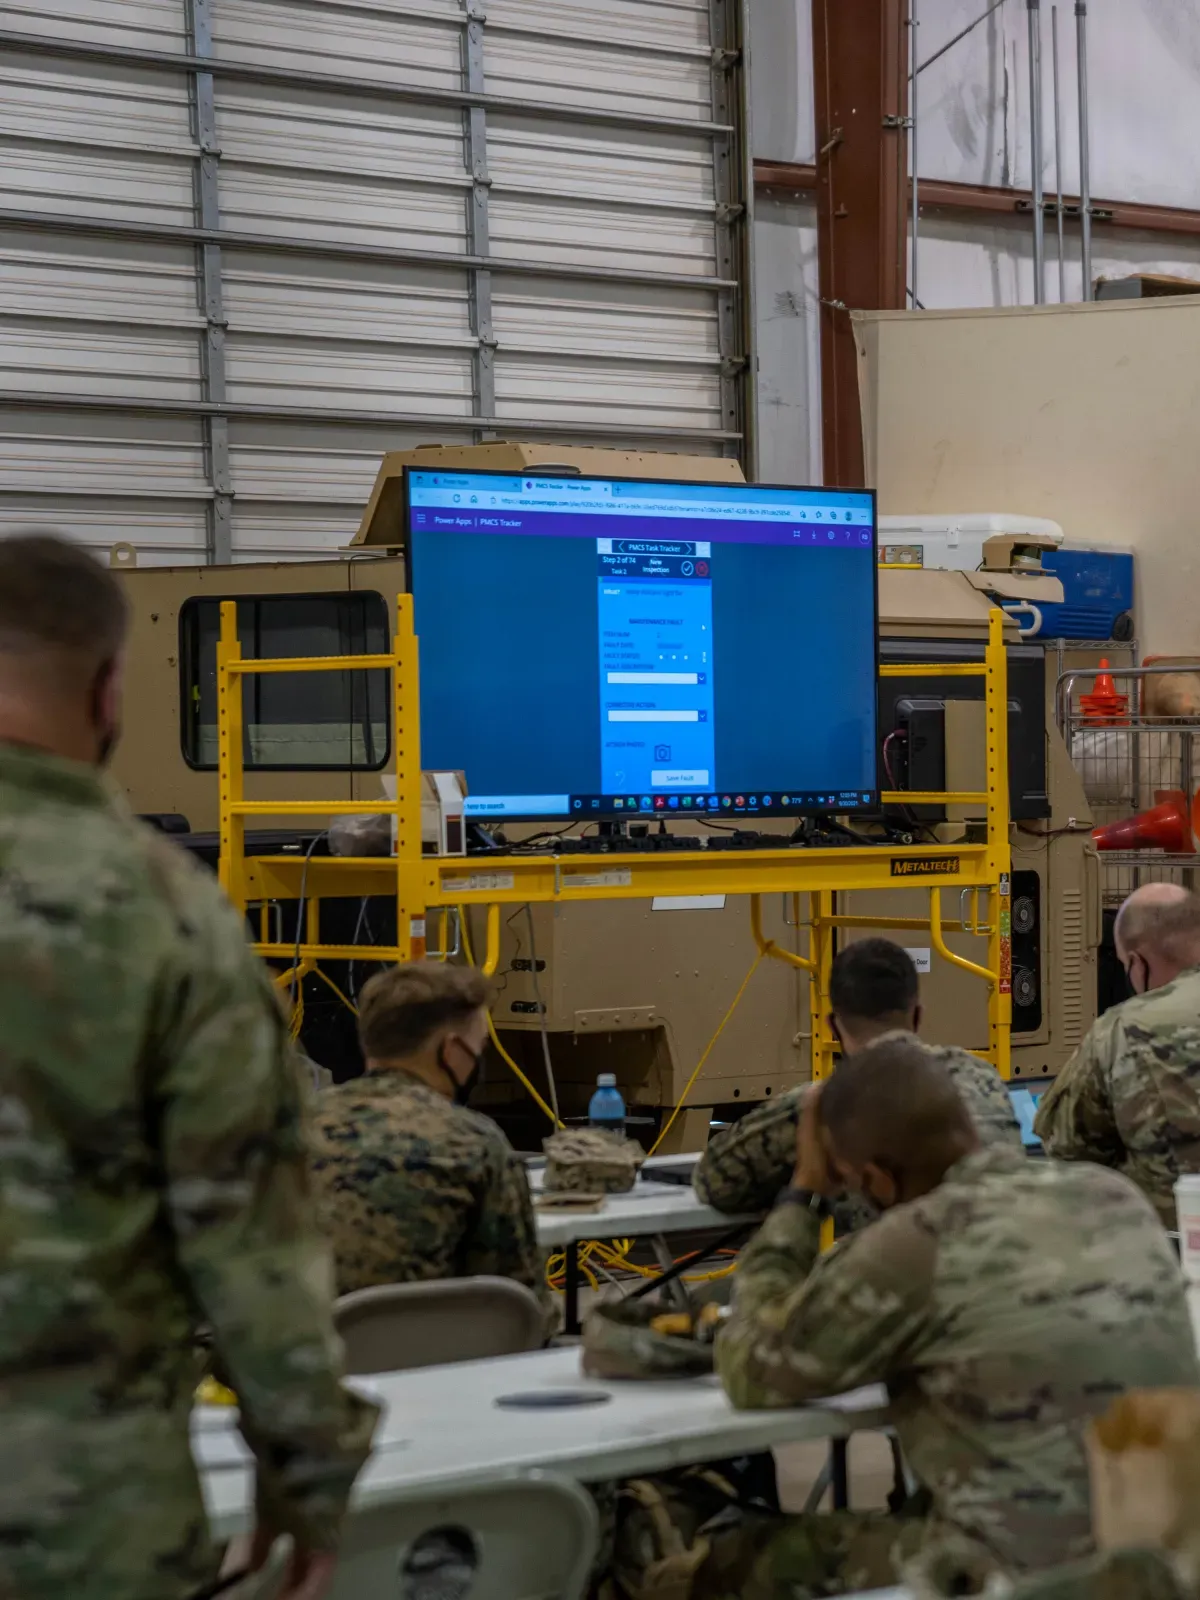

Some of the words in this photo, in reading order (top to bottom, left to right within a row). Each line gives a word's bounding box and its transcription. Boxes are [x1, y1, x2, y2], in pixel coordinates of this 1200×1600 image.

[434, 516, 455, 525] Power
[456, 517, 472, 527] Apps
[480, 518, 499, 526] PMCS
[500, 519, 522, 527] Tracker
[628, 543, 645, 551] PMCS
[602, 556, 615, 564] Step
[894, 860, 956, 874] METALTECH
